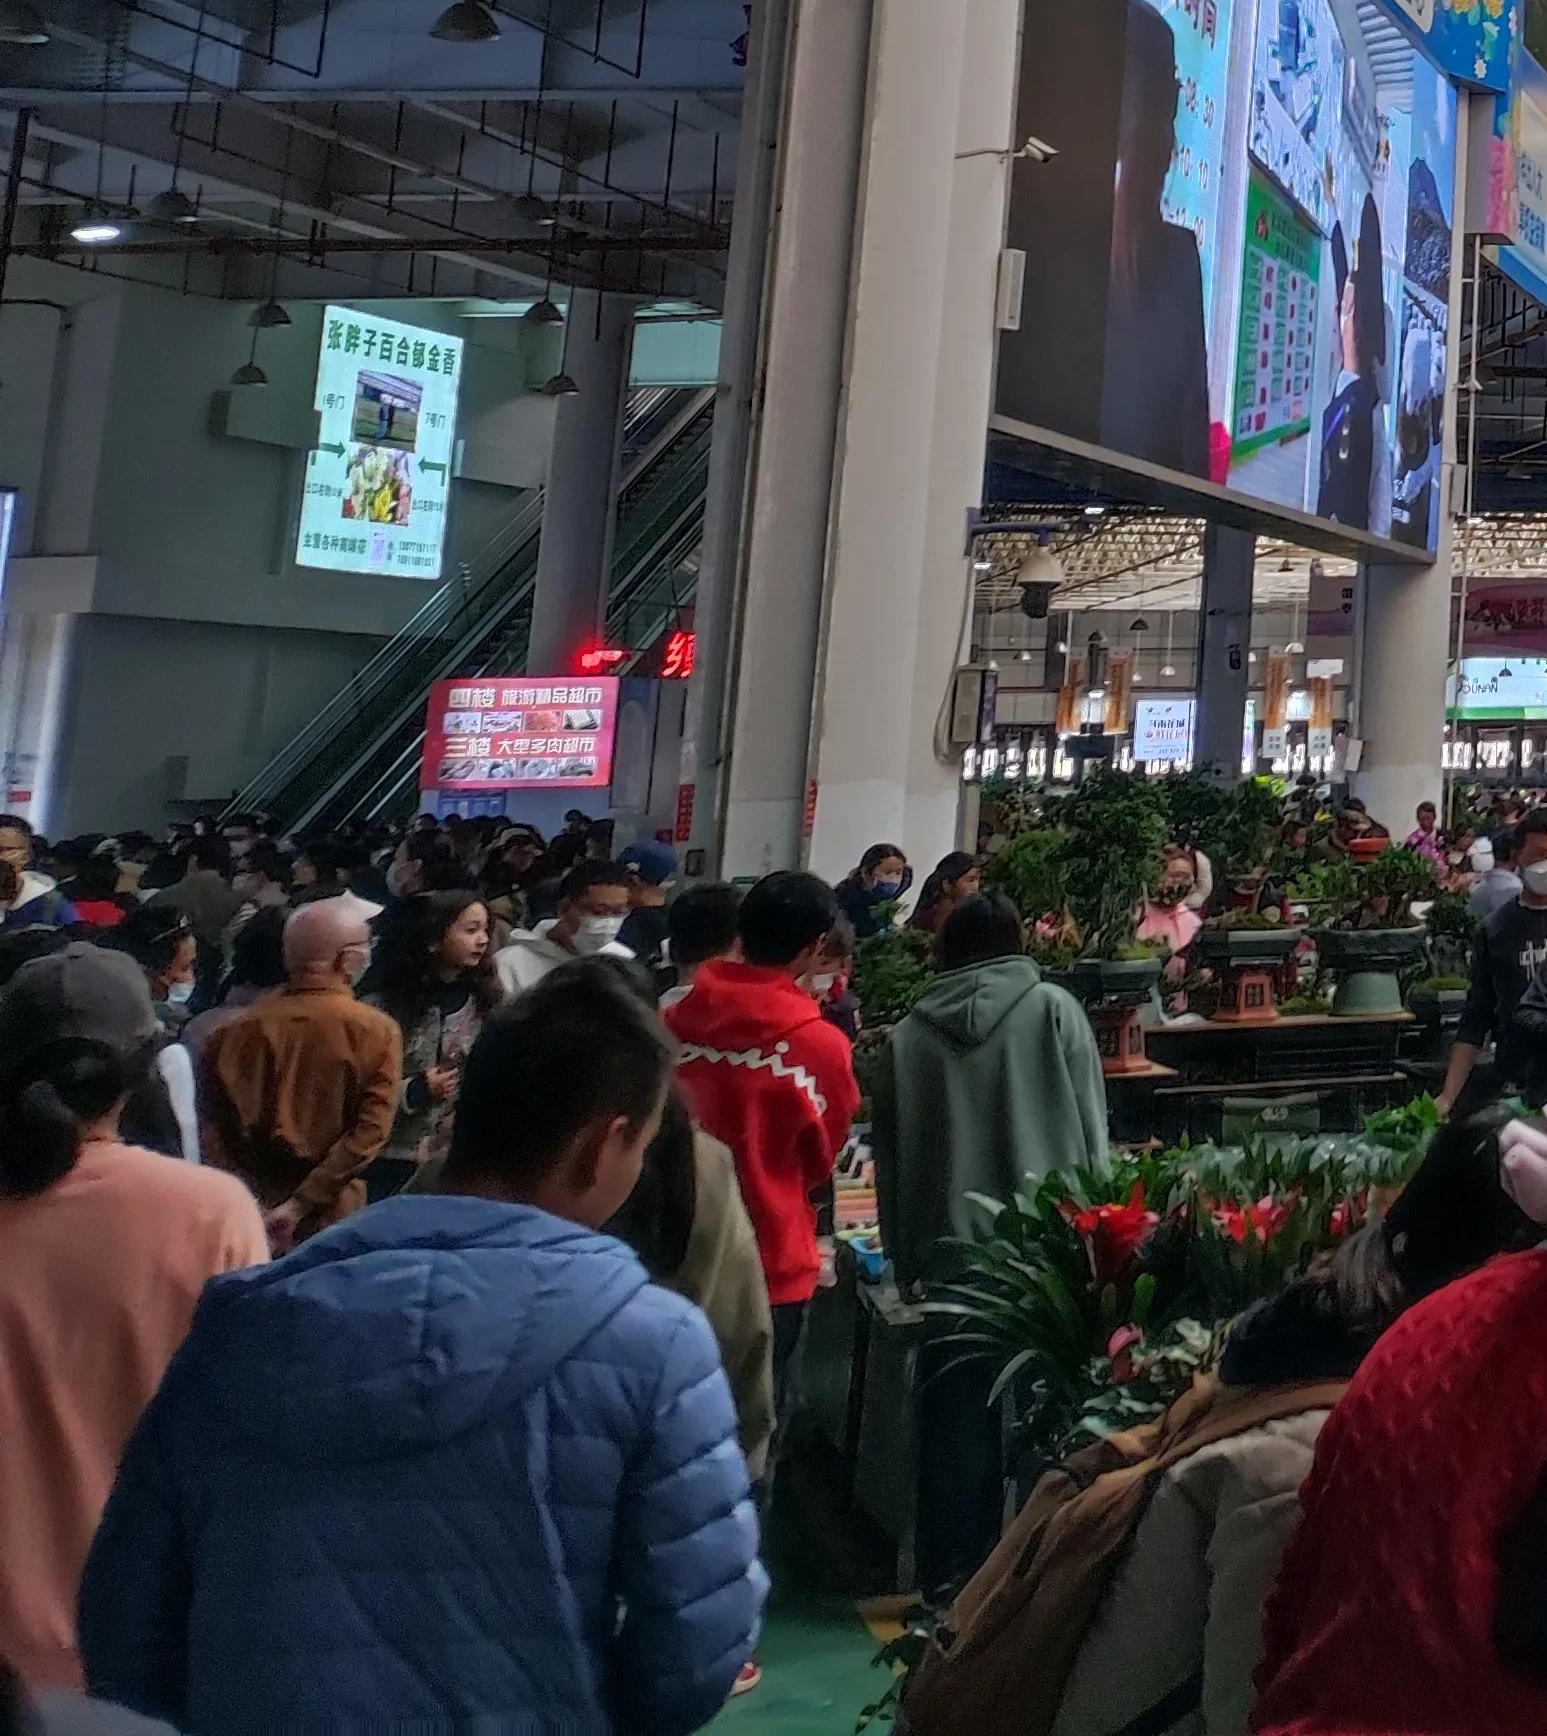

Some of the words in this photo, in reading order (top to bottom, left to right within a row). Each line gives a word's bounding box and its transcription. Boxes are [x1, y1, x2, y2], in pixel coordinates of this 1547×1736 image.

[326, 319, 457, 377] 张胖子百合郁金香
[448, 687, 496, 708] 四楼
[501, 686, 603, 706] 旅游精品超市
[444, 736, 492, 758] 三楼
[495, 736, 597, 756] 大型多肉超市
